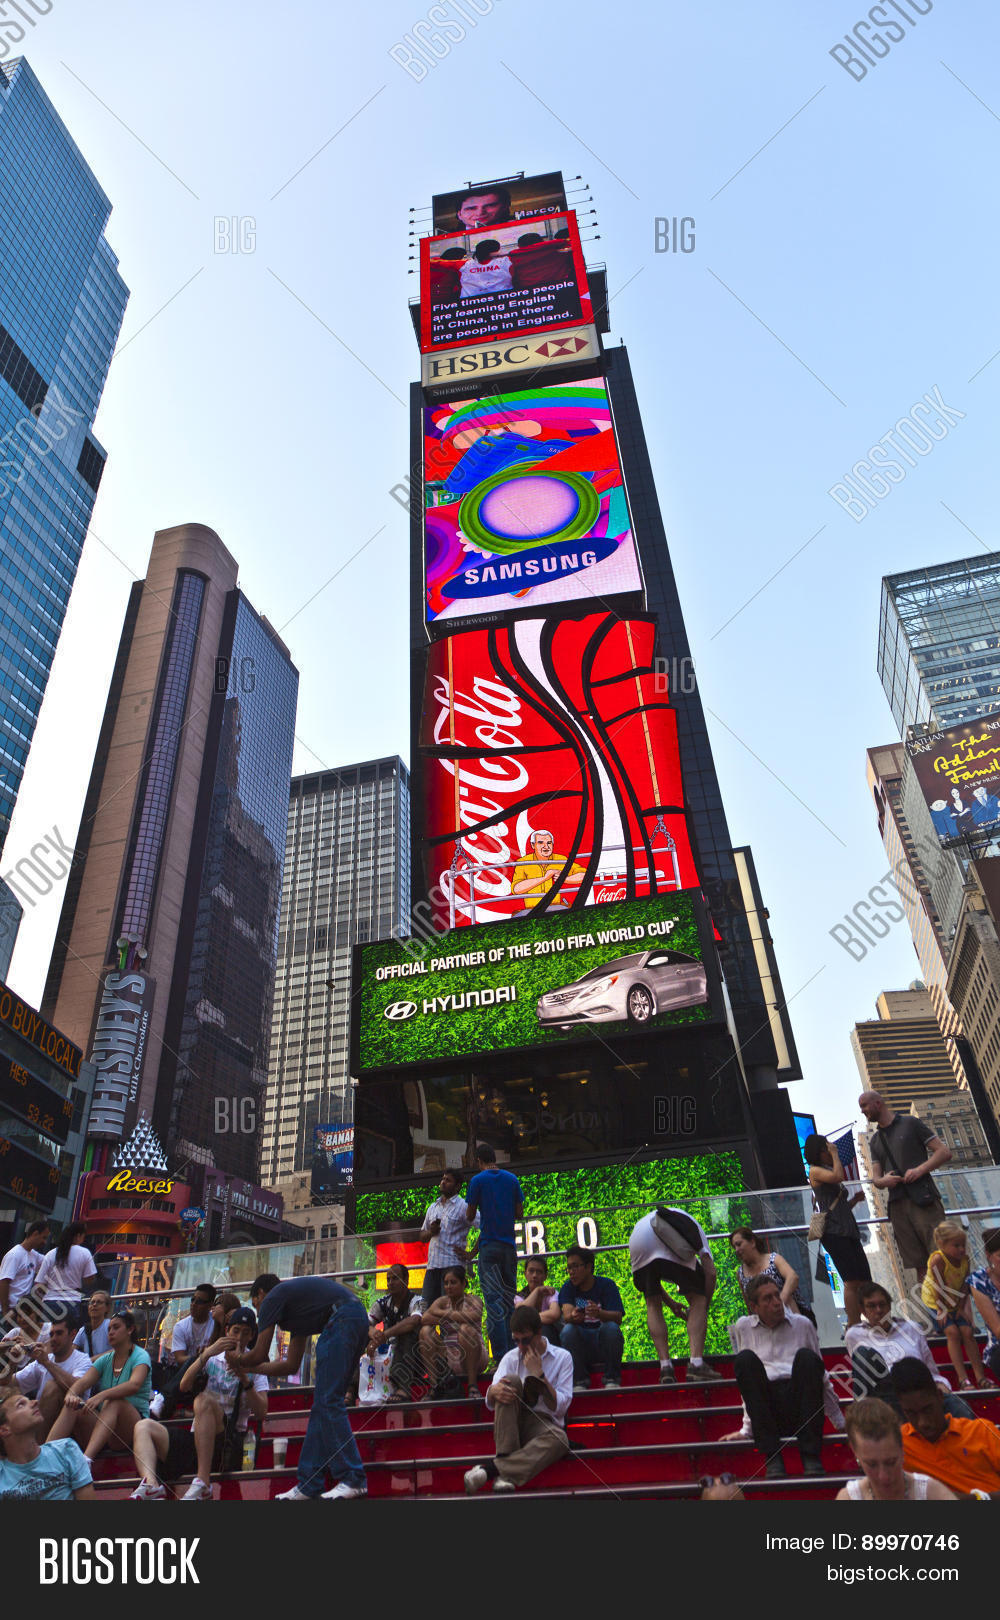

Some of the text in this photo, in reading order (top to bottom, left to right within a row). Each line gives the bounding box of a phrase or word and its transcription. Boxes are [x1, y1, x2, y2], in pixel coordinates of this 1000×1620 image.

[514, 206, 554, 217] Marco
[470, 265, 500, 274] CHINA
[433, 281, 574, 311] Five times more people
[433, 294, 555, 322] are learning English
[433, 311, 573, 341] are people in England.
[491, 311, 518, 321] than
[522, 304, 554, 315] there
[430, 345, 530, 378] HSBC
[464, 551, 597, 584] SAMSUNG
[906, 732, 944, 748] NATHAN
[909, 745, 932, 756] LANE
[952, 734, 992, 750] The
[376, 961, 428, 980] OFFICIAL
[431, 951, 485, 972] PARTNER
[488, 948, 505, 962] OF
[508, 943, 531, 959] THE
[534, 938, 564, 955] 2010
[568, 934, 595, 949] FIFA
[597, 926, 644, 944] WORLD
[423, 986, 516, 1014] HYUNDAI
[12, 1002, 41, 1042] BUY
[40, 1023, 74, 1075] LOCAL
[128, 1010, 149, 1102] Milk Chocolate
[107, 1169, 174, 1194] Reese's
[514, 1220, 546, 1257] ER
[126, 1256, 173, 1293] ERS
